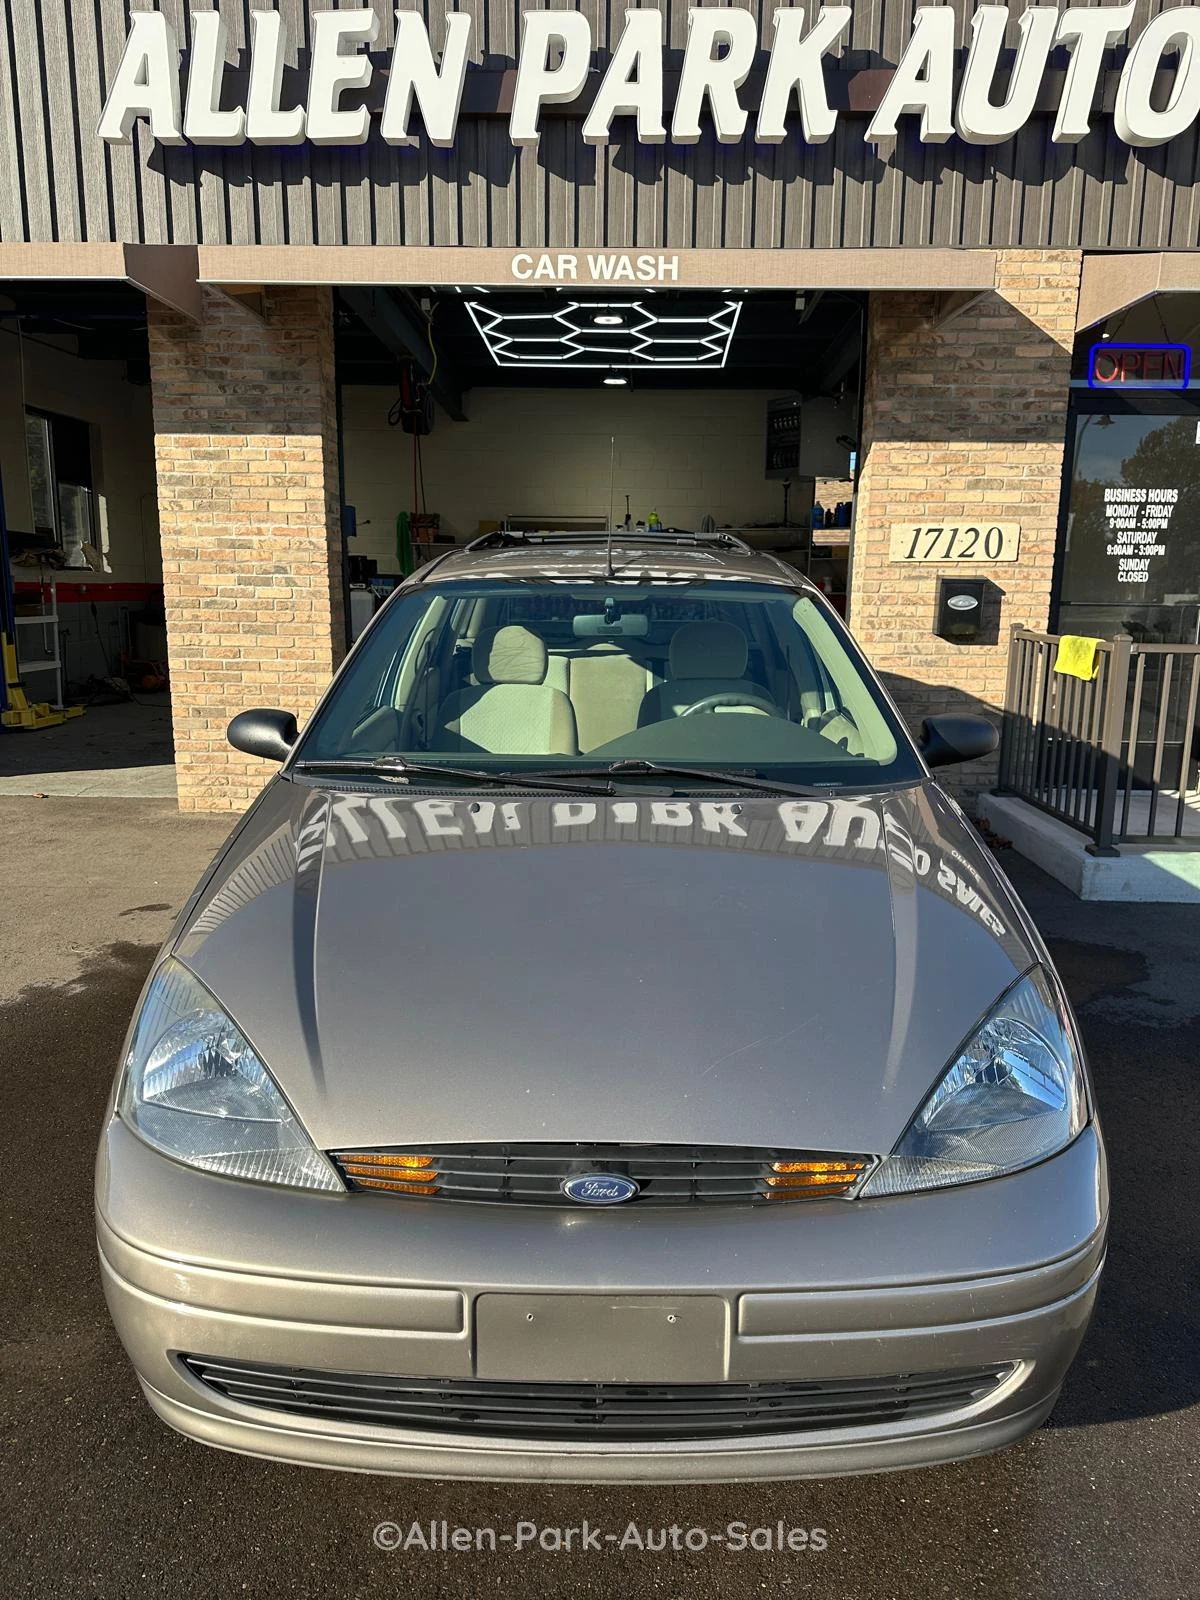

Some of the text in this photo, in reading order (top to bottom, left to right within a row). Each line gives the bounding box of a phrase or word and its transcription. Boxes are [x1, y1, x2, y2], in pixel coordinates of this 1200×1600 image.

[96, 0, 1200, 148] ALLEN PARK AUTO
[511, 253, 679, 281] CAR WASH
[1094, 351, 1185, 384] OPEN
[1104, 488, 1178, 503] BUSINESS HOURS
[1105, 504, 1139, 517] MONDAY
[1145, 505, 1174, 518] FRIDAY
[1141, 518, 1169, 529] 5:00PM
[903, 526, 1004, 560] 17120
[1117, 531, 1158, 544] SATURDAY
[1106, 544, 1134, 556] 9:00AM
[1139, 545, 1166, 556] 3:00PM
[1118, 558, 1151, 571] SUNDAY
[1117, 571, 1149, 583] CLOSED
[581, 1181, 619, 1197] Ford
